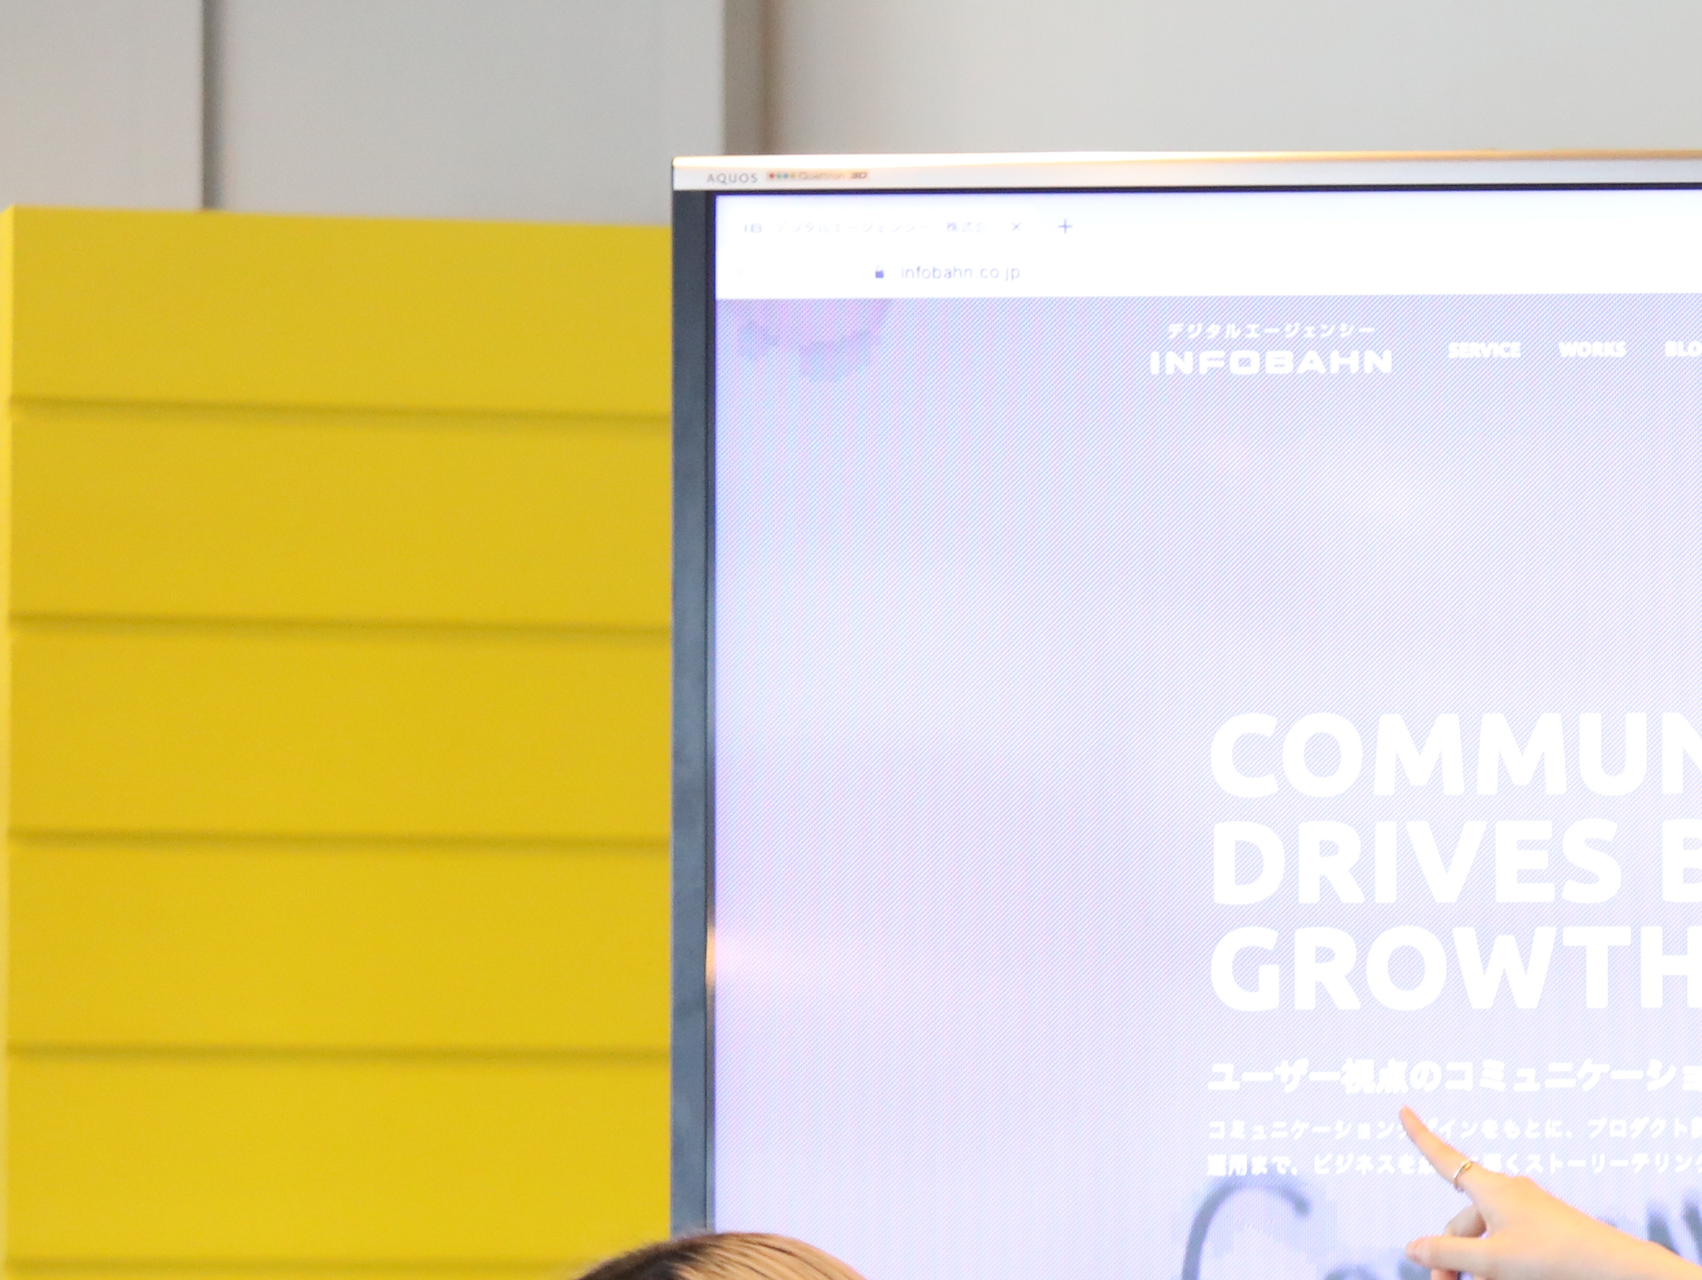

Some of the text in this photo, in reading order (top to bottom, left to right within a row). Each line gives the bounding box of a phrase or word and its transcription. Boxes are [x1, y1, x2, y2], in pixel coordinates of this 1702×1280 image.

[706, 172, 758, 184] AQUOS
[1167, 322, 1375, 340] デジタルエージェンシー
[1447, 341, 1522, 359] SERVICE
[1558, 340, 1627, 358] WORKS
[1149, 349, 1393, 376] INFOBAHN
[1212, 815, 1623, 906] DRIVES
